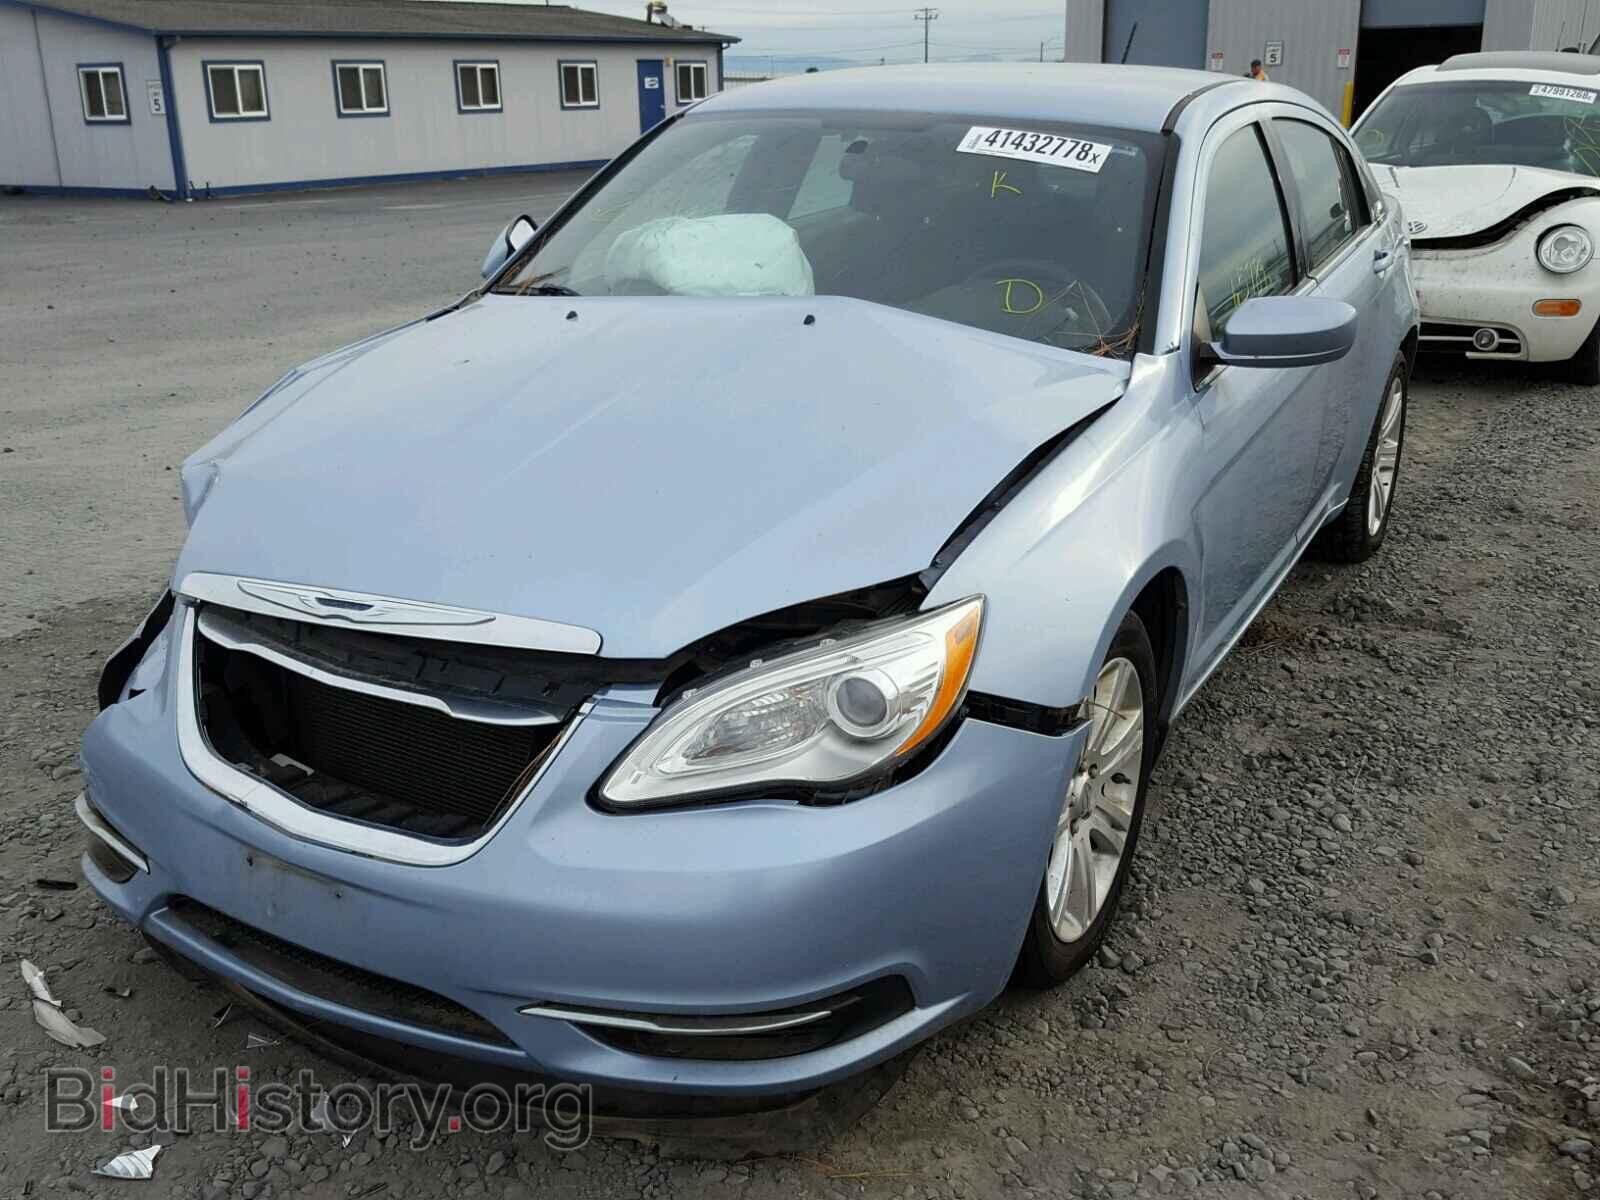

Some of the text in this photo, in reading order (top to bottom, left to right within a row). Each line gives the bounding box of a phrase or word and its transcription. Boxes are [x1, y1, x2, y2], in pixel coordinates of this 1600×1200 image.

[1269, 53, 1278, 63] 5
[153, 98, 161, 112] 5
[991, 170, 1022, 198] K
[993, 278, 1043, 314] D
